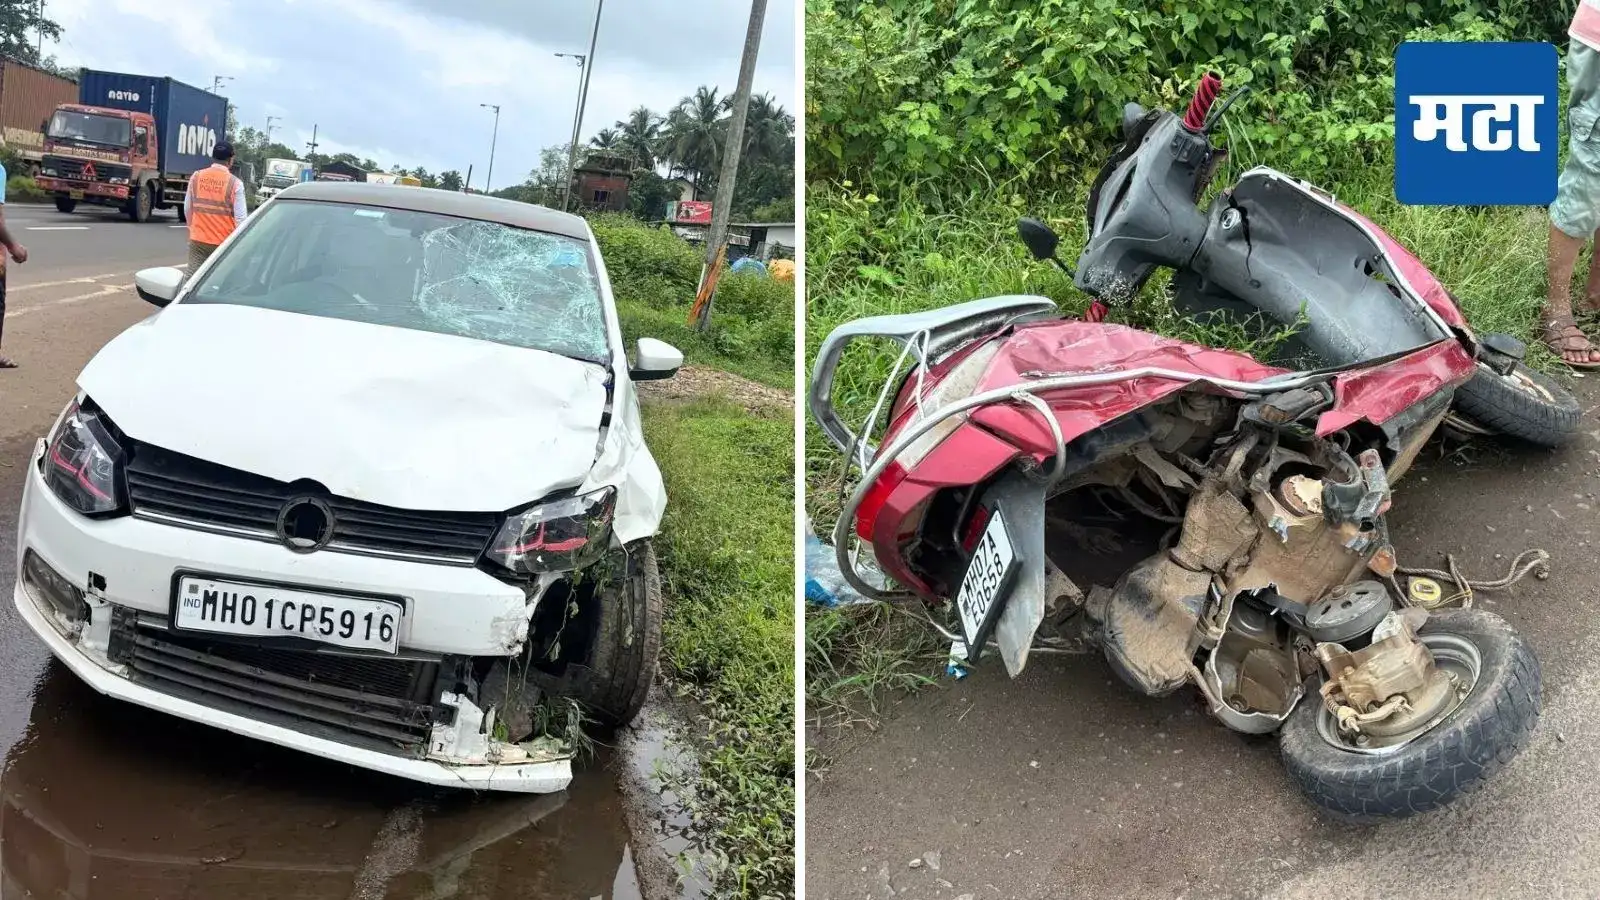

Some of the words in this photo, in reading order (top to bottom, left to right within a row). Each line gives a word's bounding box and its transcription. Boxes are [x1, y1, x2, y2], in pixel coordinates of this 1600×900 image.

[964, 530, 996, 604] MH07A
[971, 553, 1003, 626] E0658
[183, 598, 201, 608] IND
[201, 590, 394, 643] MH01CP5916
